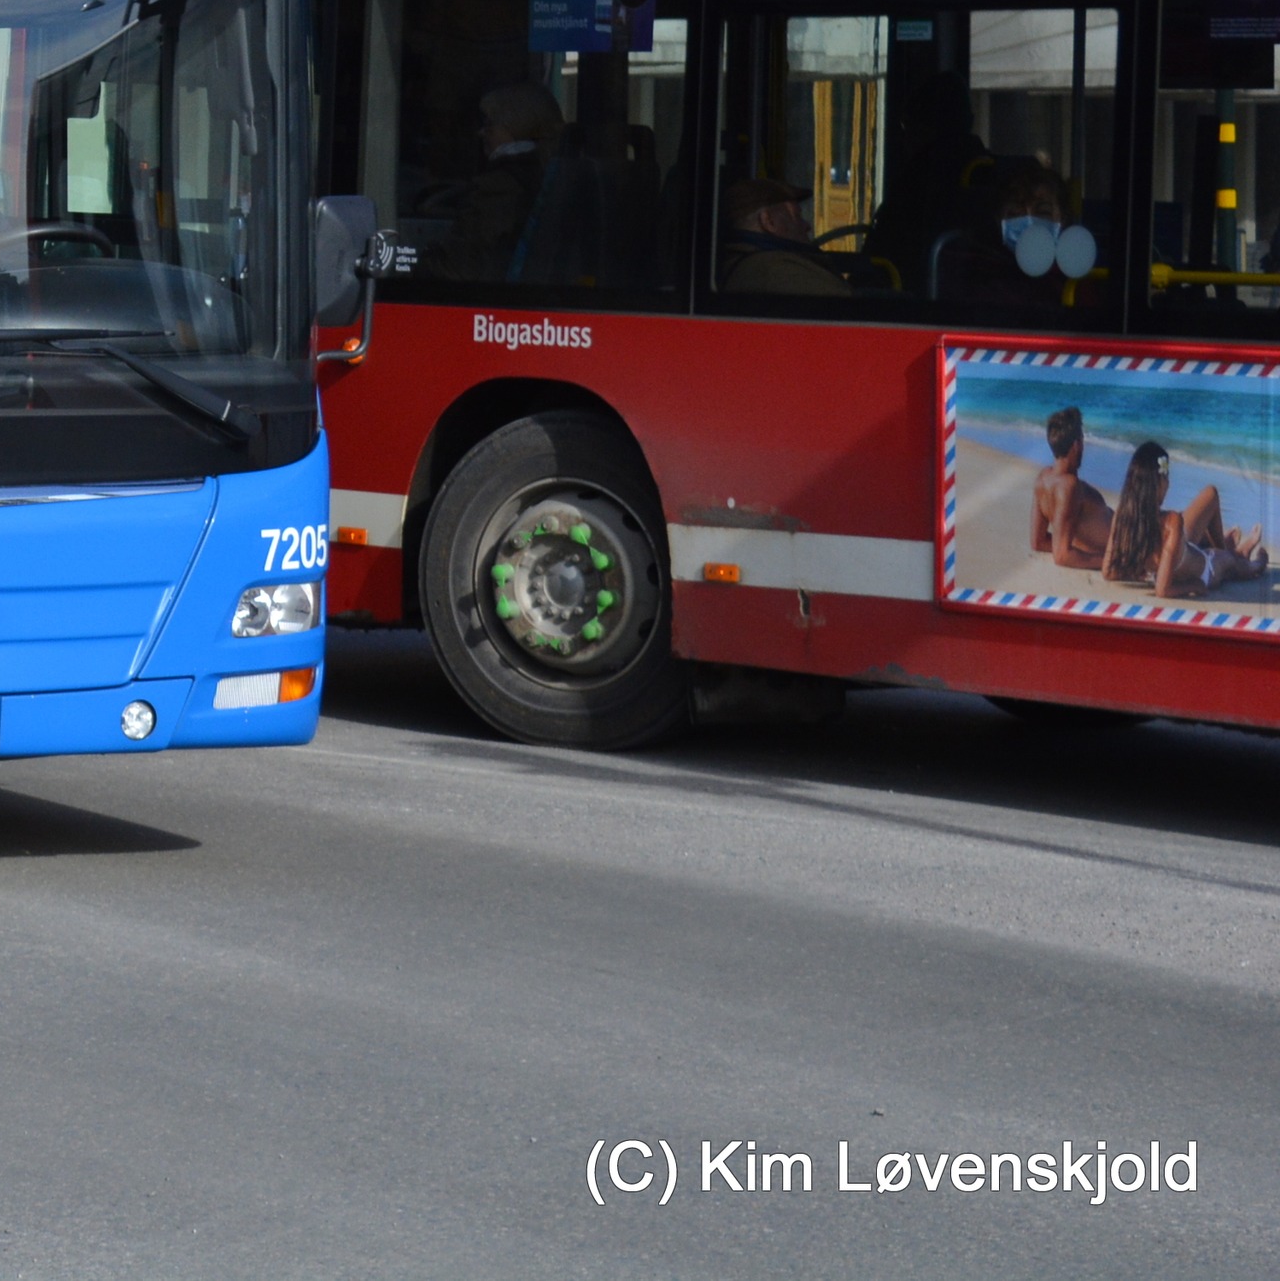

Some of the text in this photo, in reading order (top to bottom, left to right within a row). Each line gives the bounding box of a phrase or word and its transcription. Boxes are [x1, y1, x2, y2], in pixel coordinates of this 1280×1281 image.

[533, 1, 568, 14] Din nya
[533, 16, 588, 31] musiktjänst
[473, 314, 593, 351] Biogasbuss
[261, 524, 327, 572] 7205
